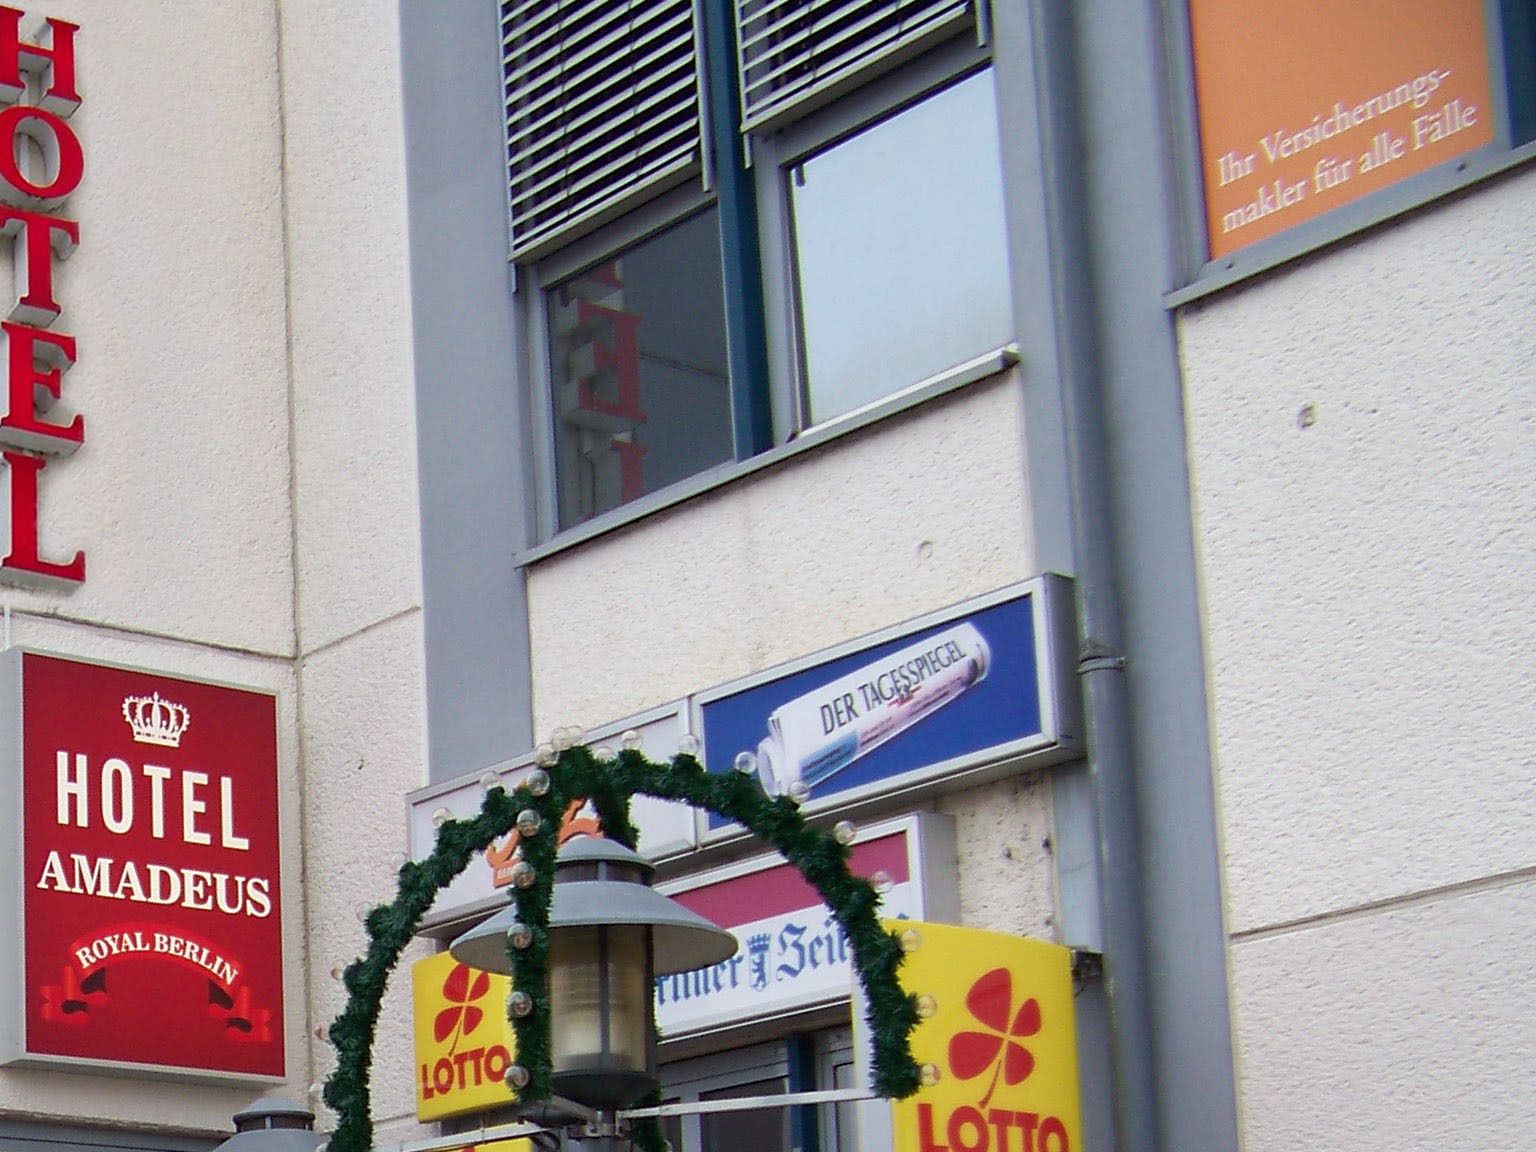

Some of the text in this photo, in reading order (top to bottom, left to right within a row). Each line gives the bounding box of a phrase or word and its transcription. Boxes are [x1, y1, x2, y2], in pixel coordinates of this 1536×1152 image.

[1218, 69, 1451, 187] Ihr Versicherungs-
[1222, 100, 1478, 234] makler für alle Fälle
[820, 693, 861, 735] DER
[858, 638, 967, 713] TAGESSPIEGEL
[57, 751, 250, 850] HOTEL
[37, 851, 271, 918] AMADEUS
[75, 932, 239, 985] ROYAL BERLIN
[421, 1044, 512, 1100] LOTTO
